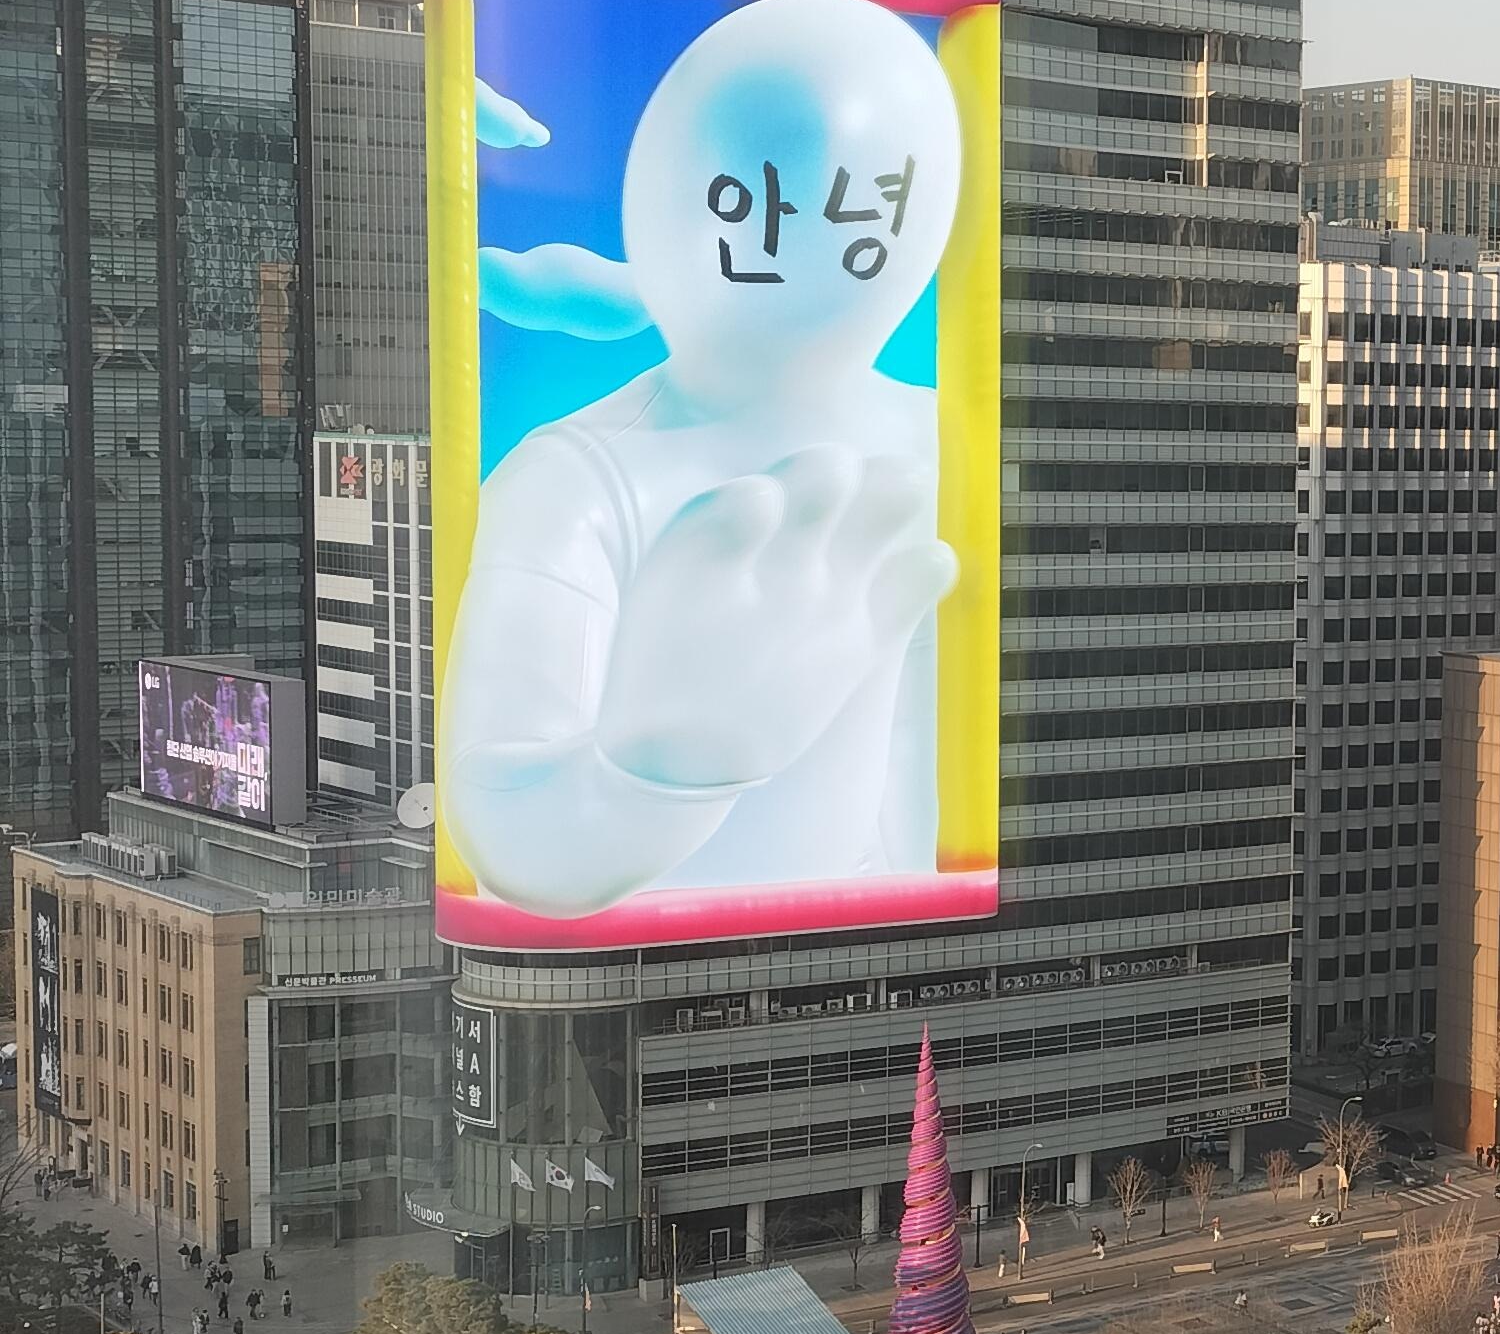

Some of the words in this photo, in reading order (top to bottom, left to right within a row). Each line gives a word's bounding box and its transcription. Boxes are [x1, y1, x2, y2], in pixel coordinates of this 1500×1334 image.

[707, 154, 916, 283] 안녕
[151, 676, 160, 688] LG
[237, 774, 265, 812] 같이
[412, 1203, 444, 1224] STUDIO
